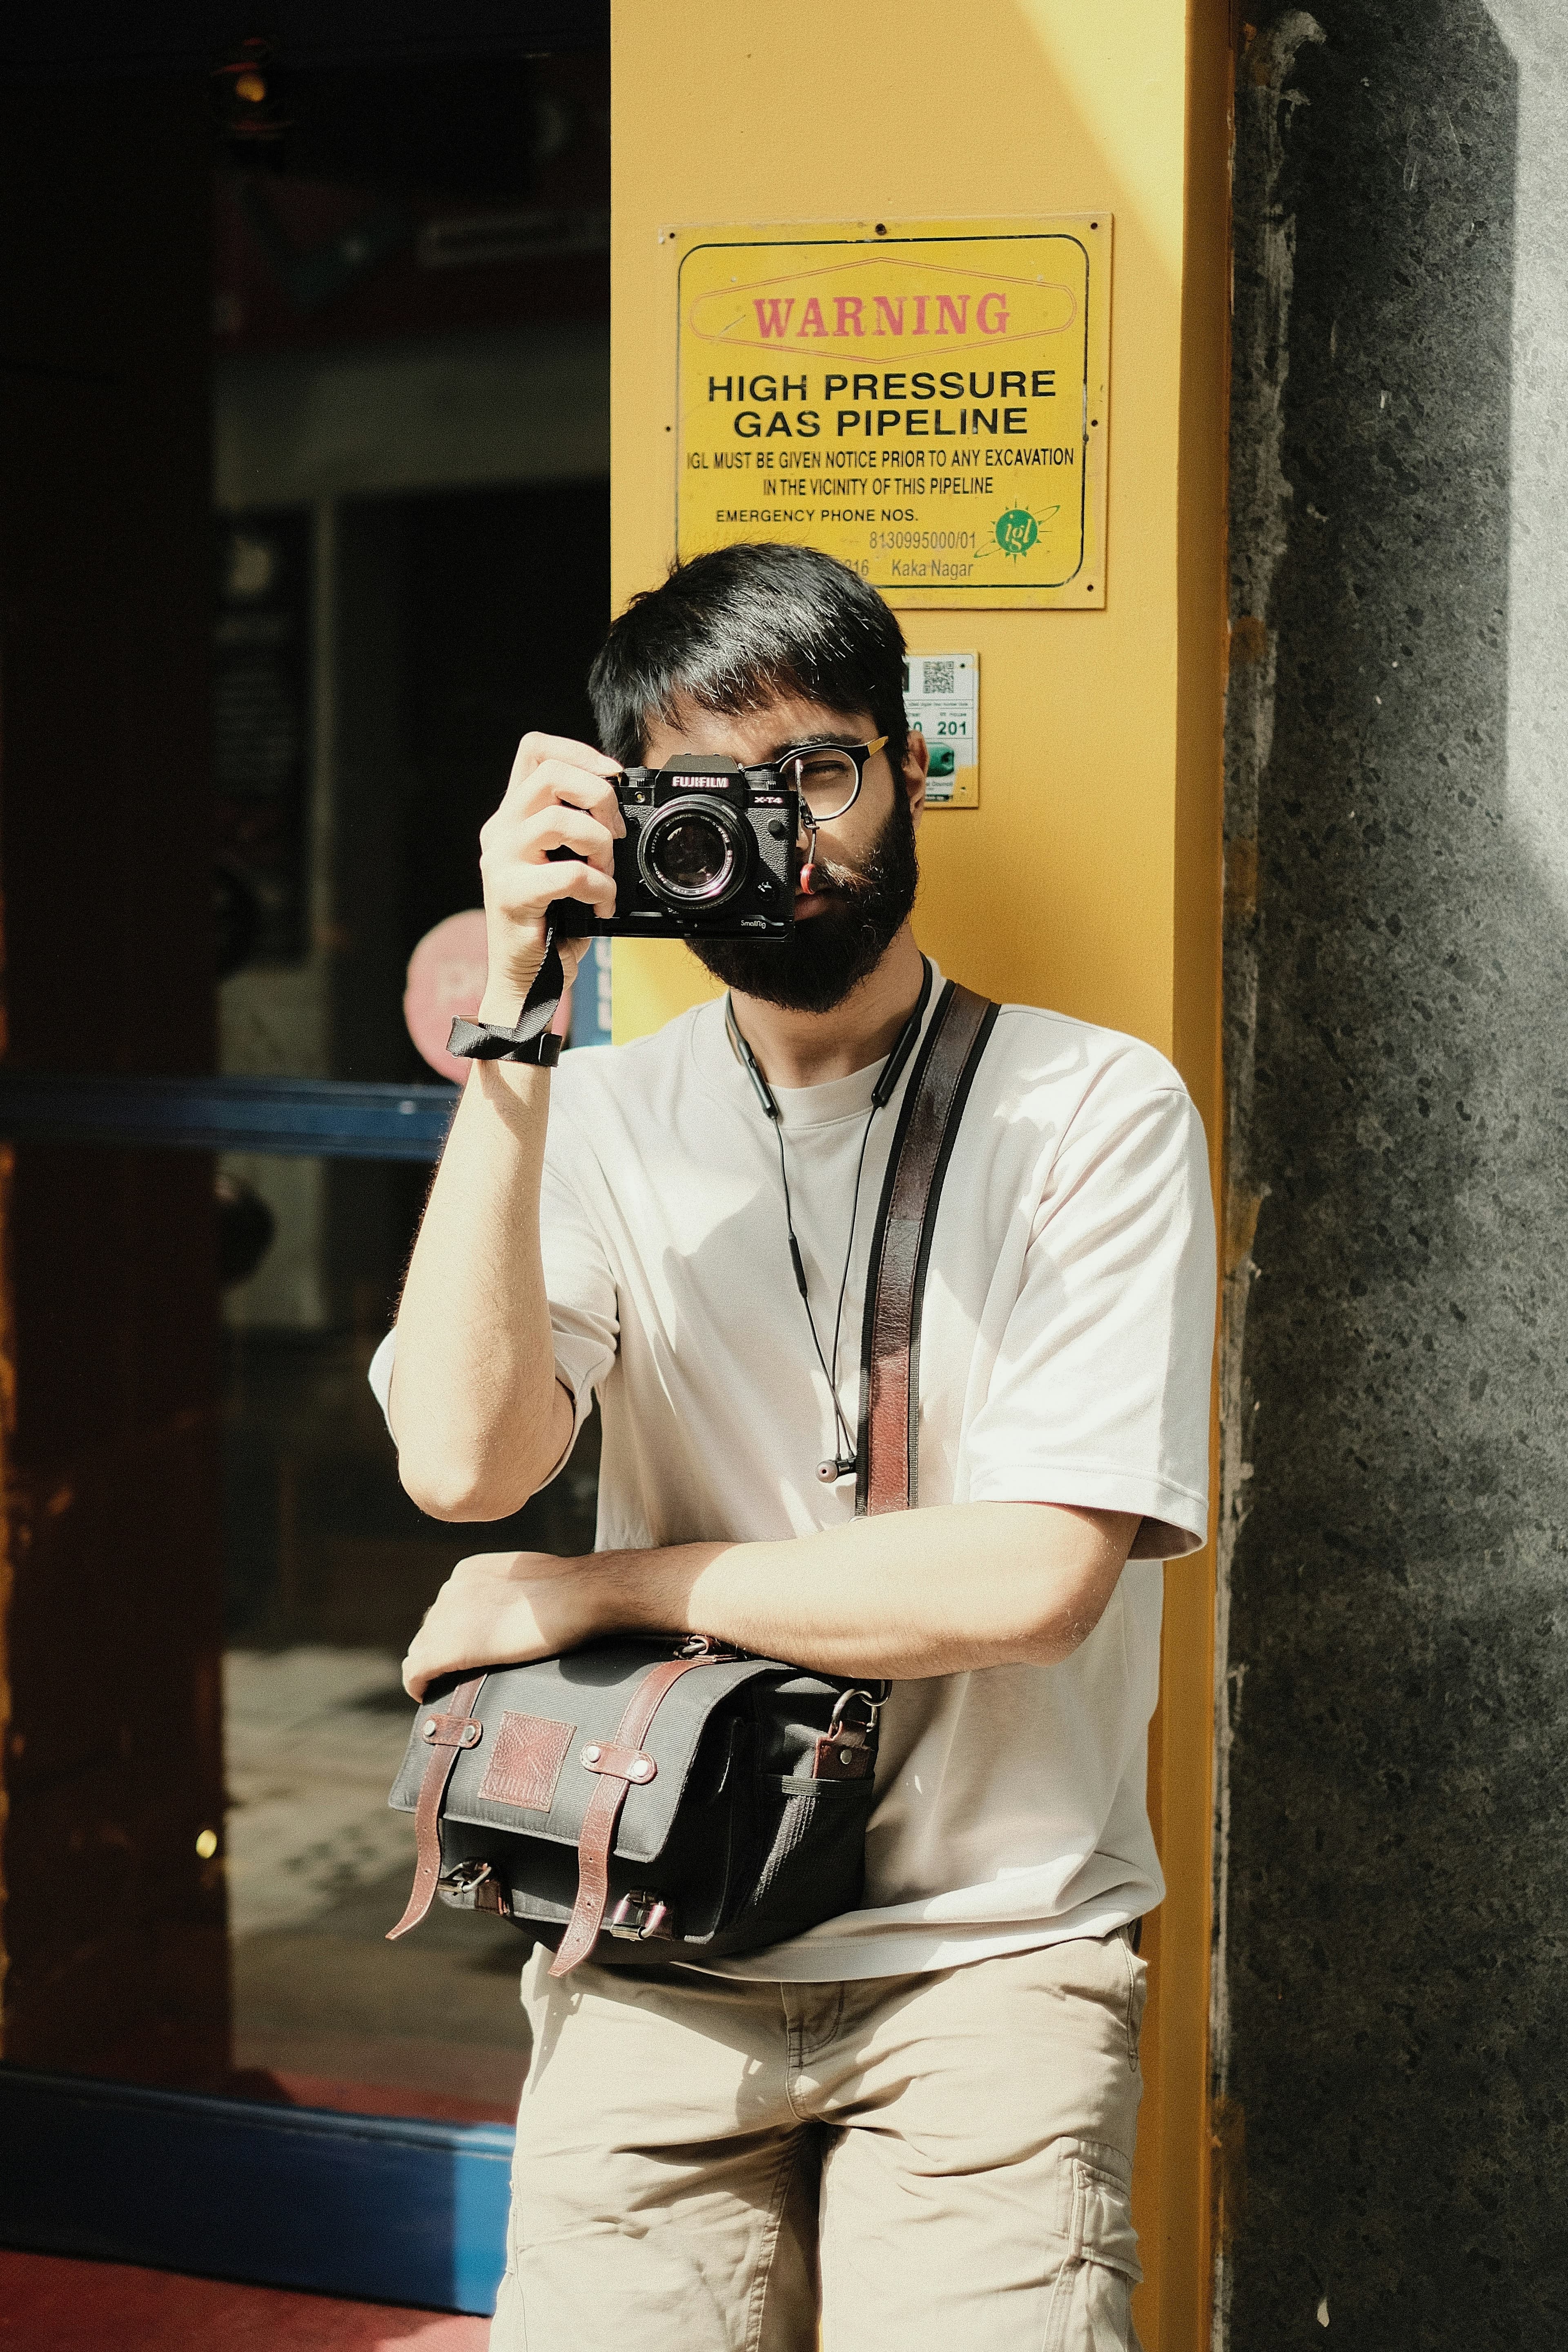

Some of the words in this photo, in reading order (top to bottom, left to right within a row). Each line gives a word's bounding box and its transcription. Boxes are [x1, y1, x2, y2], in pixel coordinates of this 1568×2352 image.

[753, 293, 1009, 338] WARNING
[709, 375, 806, 401] HIGH
[825, 370, 1056, 400] PRESSURE
[734, 411, 820, 438] GAS
[838, 408, 1027, 436] PIPELINE
[688, 452, 708, 469] IGL
[714, 452, 751, 469] MUST
[757, 452, 773, 468] BE
[780, 452, 820, 468] GIVEN
[826, 451, 876, 468] NOTICE
[882, 450, 924, 467] PRIOR
[929, 450, 946, 467] TO
[951, 450, 980, 466] ANY
[986, 448, 1074, 466] EXCAVATION
[764, 480, 776, 494] IN
[780, 479, 806, 495] THE
[811, 479, 867, 495] VICINITY
[873, 478, 891, 495] OF
[895, 478, 925, 494] THIS
[931, 477, 993, 494] PIPELINE
[717, 510, 814, 522] EMERGENCY
[821, 509, 875, 521] PHONE
[881, 509, 918, 521] NOS.
[870, 531, 975, 549] 8130995000/01
[892, 559, 926, 576] Kaka
[931, 558, 973, 580] Nagar
[938, 721, 966, 735] 201
[672, 776, 729, 788] FUJIFILM
[741, 920, 766, 929] SmallRig
